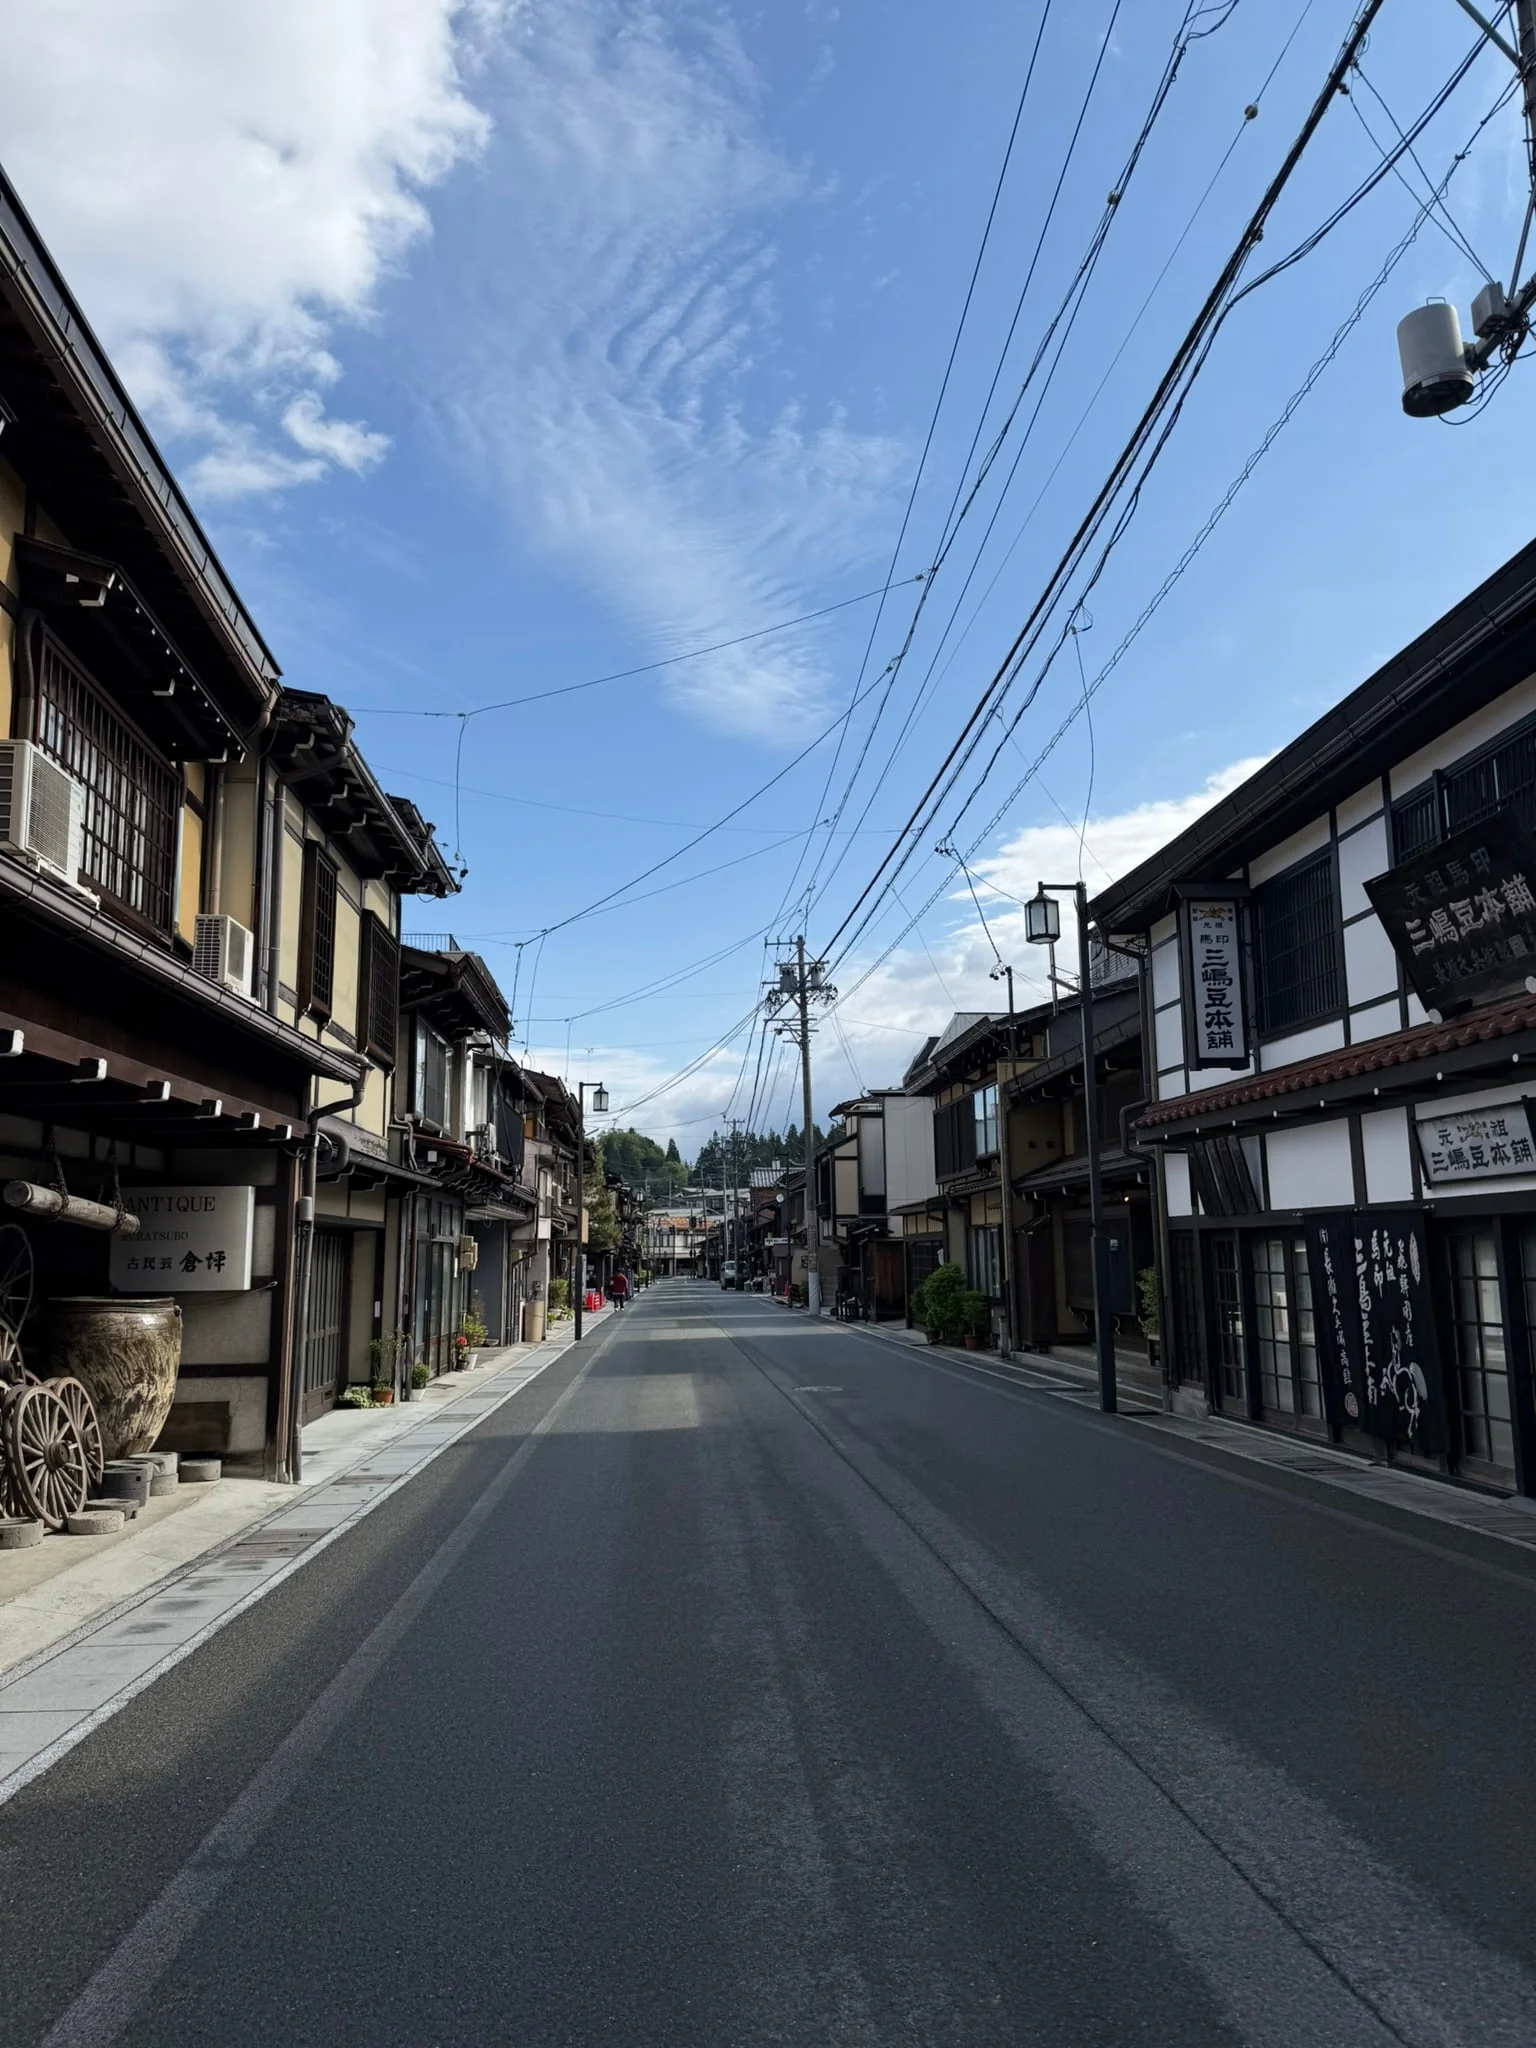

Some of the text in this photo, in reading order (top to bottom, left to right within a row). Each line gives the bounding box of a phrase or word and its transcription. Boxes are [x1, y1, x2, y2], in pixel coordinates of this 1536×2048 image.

[1403, 845, 1493, 907] 元祖馬印
[1199, 934, 1229, 945] 馬印
[1201, 948, 1235, 1050] 三嶋豆本舗
[1431, 1137, 1534, 1175] 三嶋豆本舗
[125, 1196, 216, 1212] ANTIQUE
[127, 1250, 226, 1273] 古民芸 倉坪
